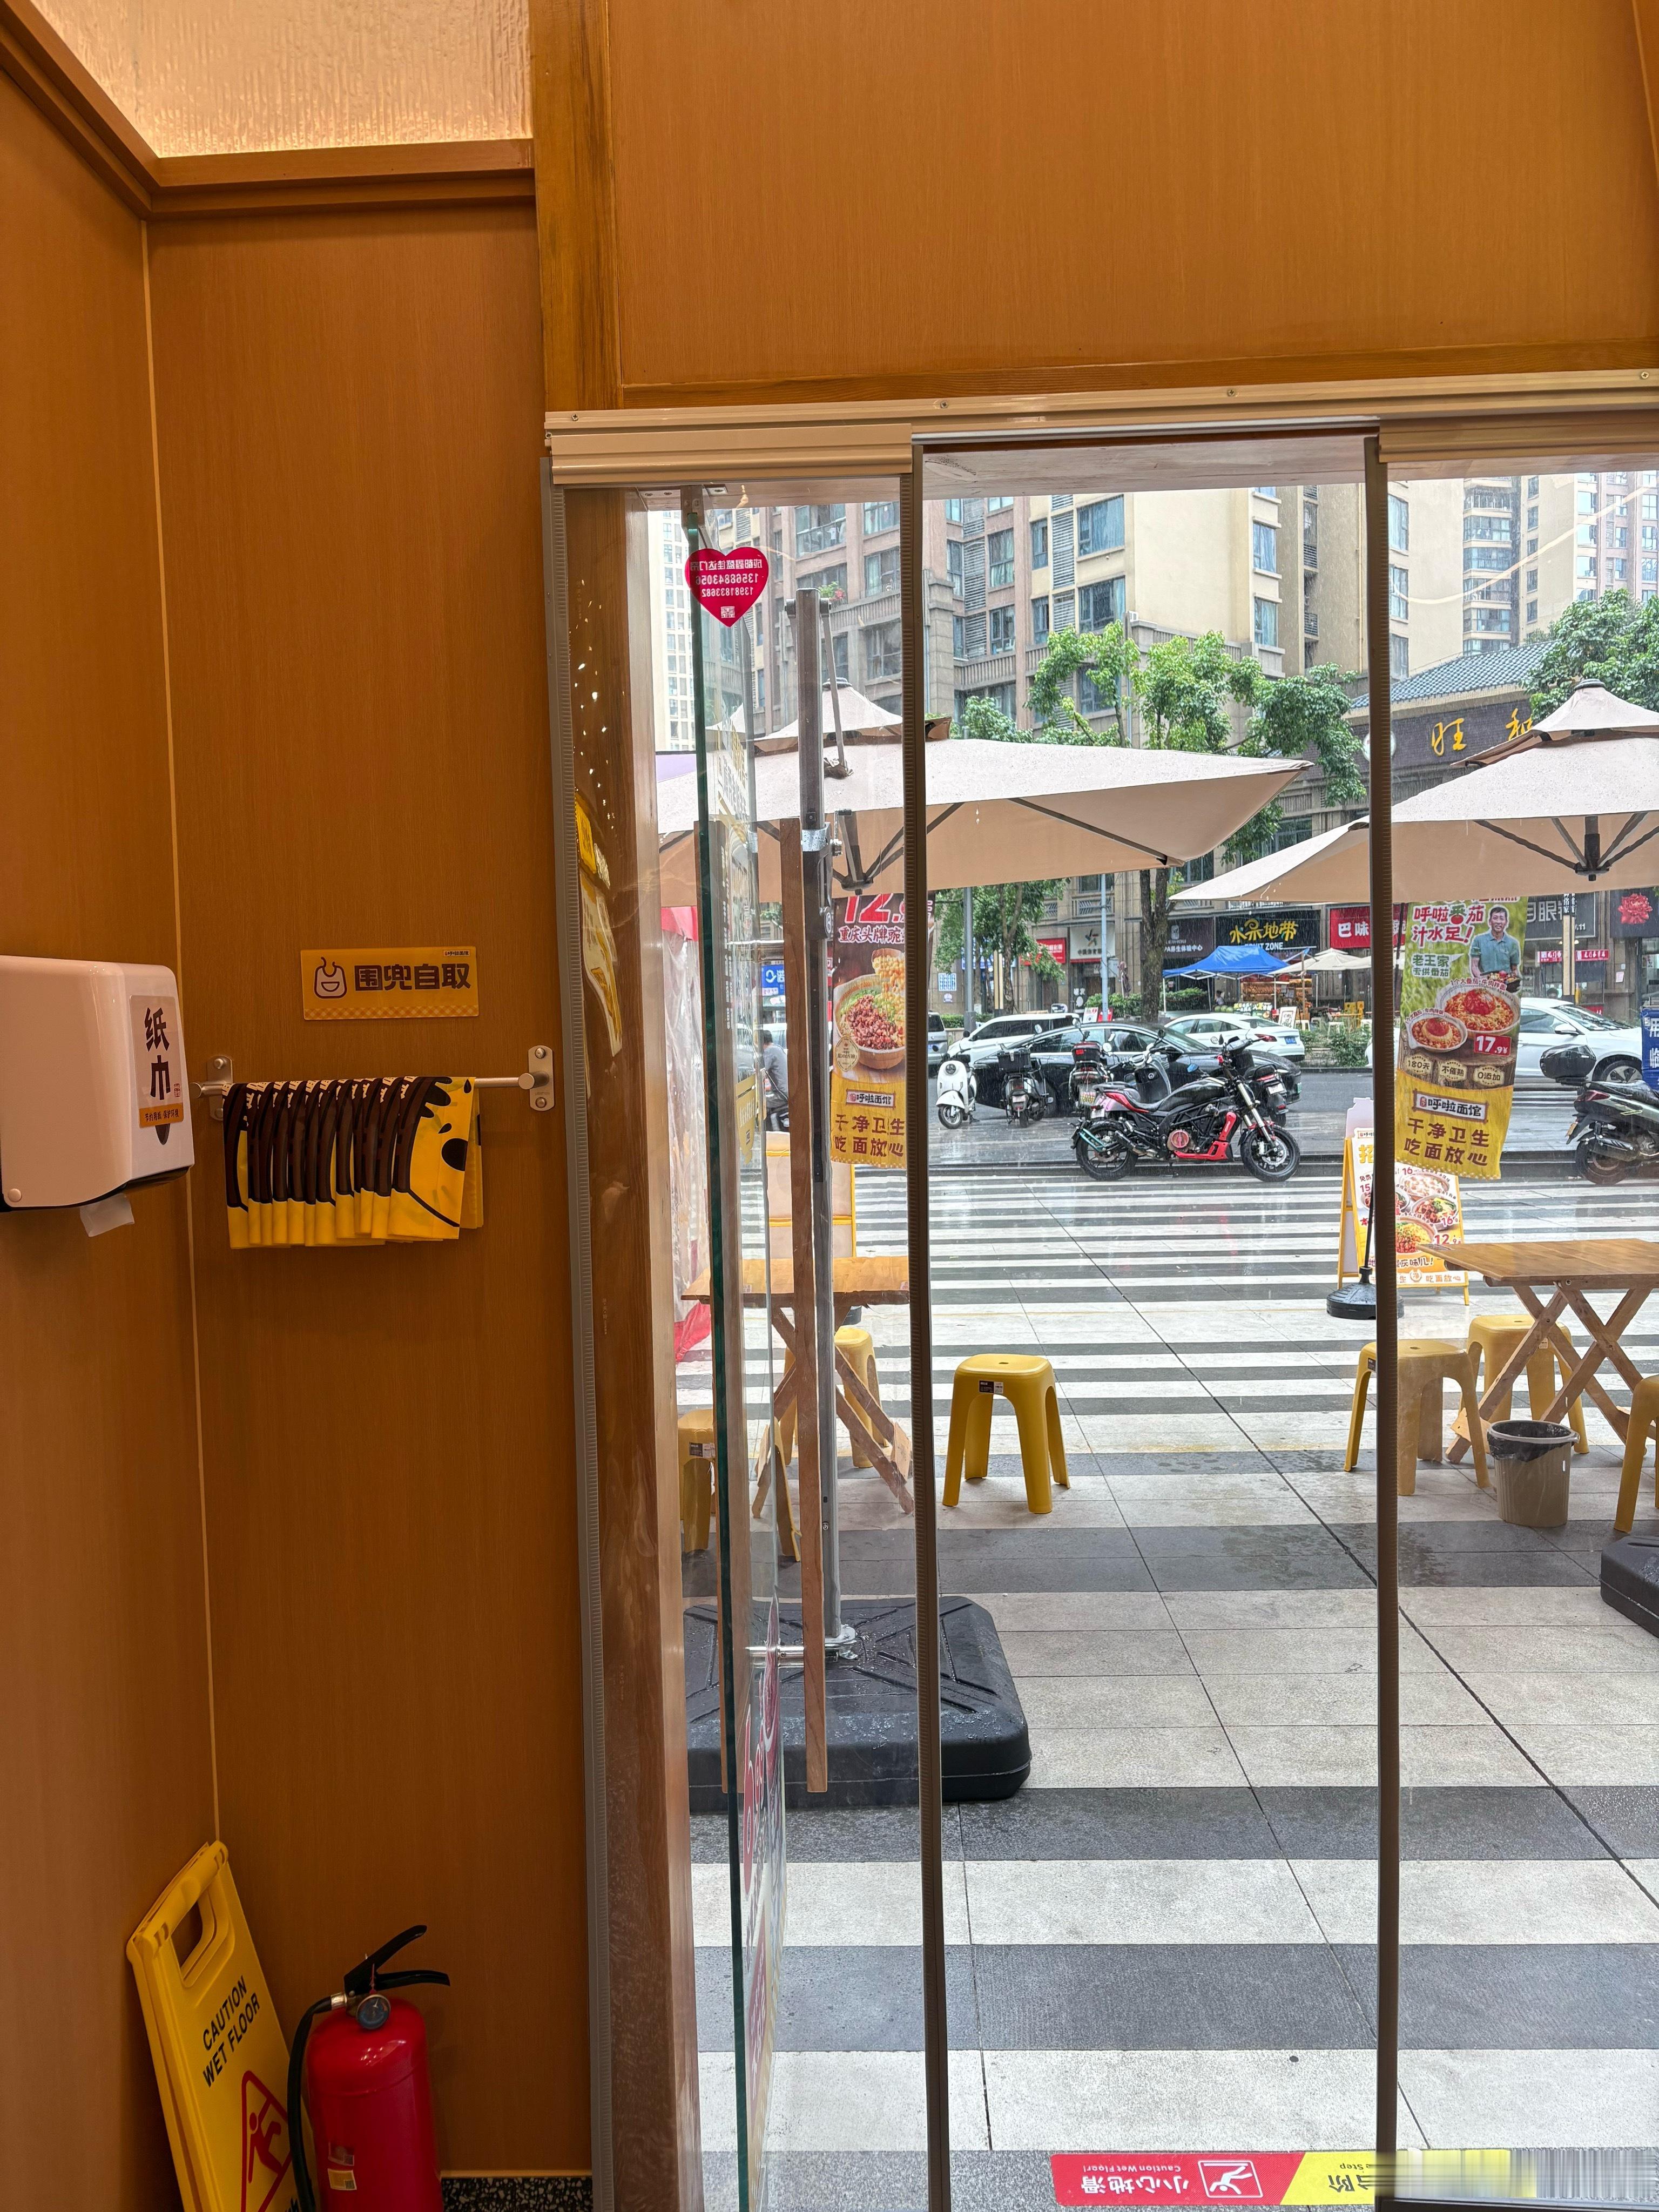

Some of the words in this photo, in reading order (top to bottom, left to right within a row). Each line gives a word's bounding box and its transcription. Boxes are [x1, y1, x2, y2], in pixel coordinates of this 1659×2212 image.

[1413, 905, 1485, 925] 呼啦番茄
[839, 926, 905, 944] 重庆头牌豌
[1230, 918, 1298, 943] 水果地带
[1265, 942, 1284, 951] ZONE
[1413, 954, 1450, 967] 老王家
[354, 963, 471, 991] 围兜自取
[144, 1007, 170, 1101] 纸巾
[1407, 1060, 1430, 1070] 180天
[1441, 1065, 1464, 1077] 不催熟
[1428, 1098, 1482, 1117] 呼啦面馆
[835, 1114, 905, 1136] 干净卫生
[1407, 1117, 1489, 1148] 干净卫生
[835, 1135, 903, 1157] 吃面放心
[1404, 1137, 1488, 1166] 吃面放心
[203, 1975, 247, 2051] CAUTION
[203, 2041, 227, 2088] WET
[227, 1992, 260, 2053] FLOOR
[1139, 2164, 1181, 2173] Caution
[1081, 2175, 1189, 2195] 小心地滑
